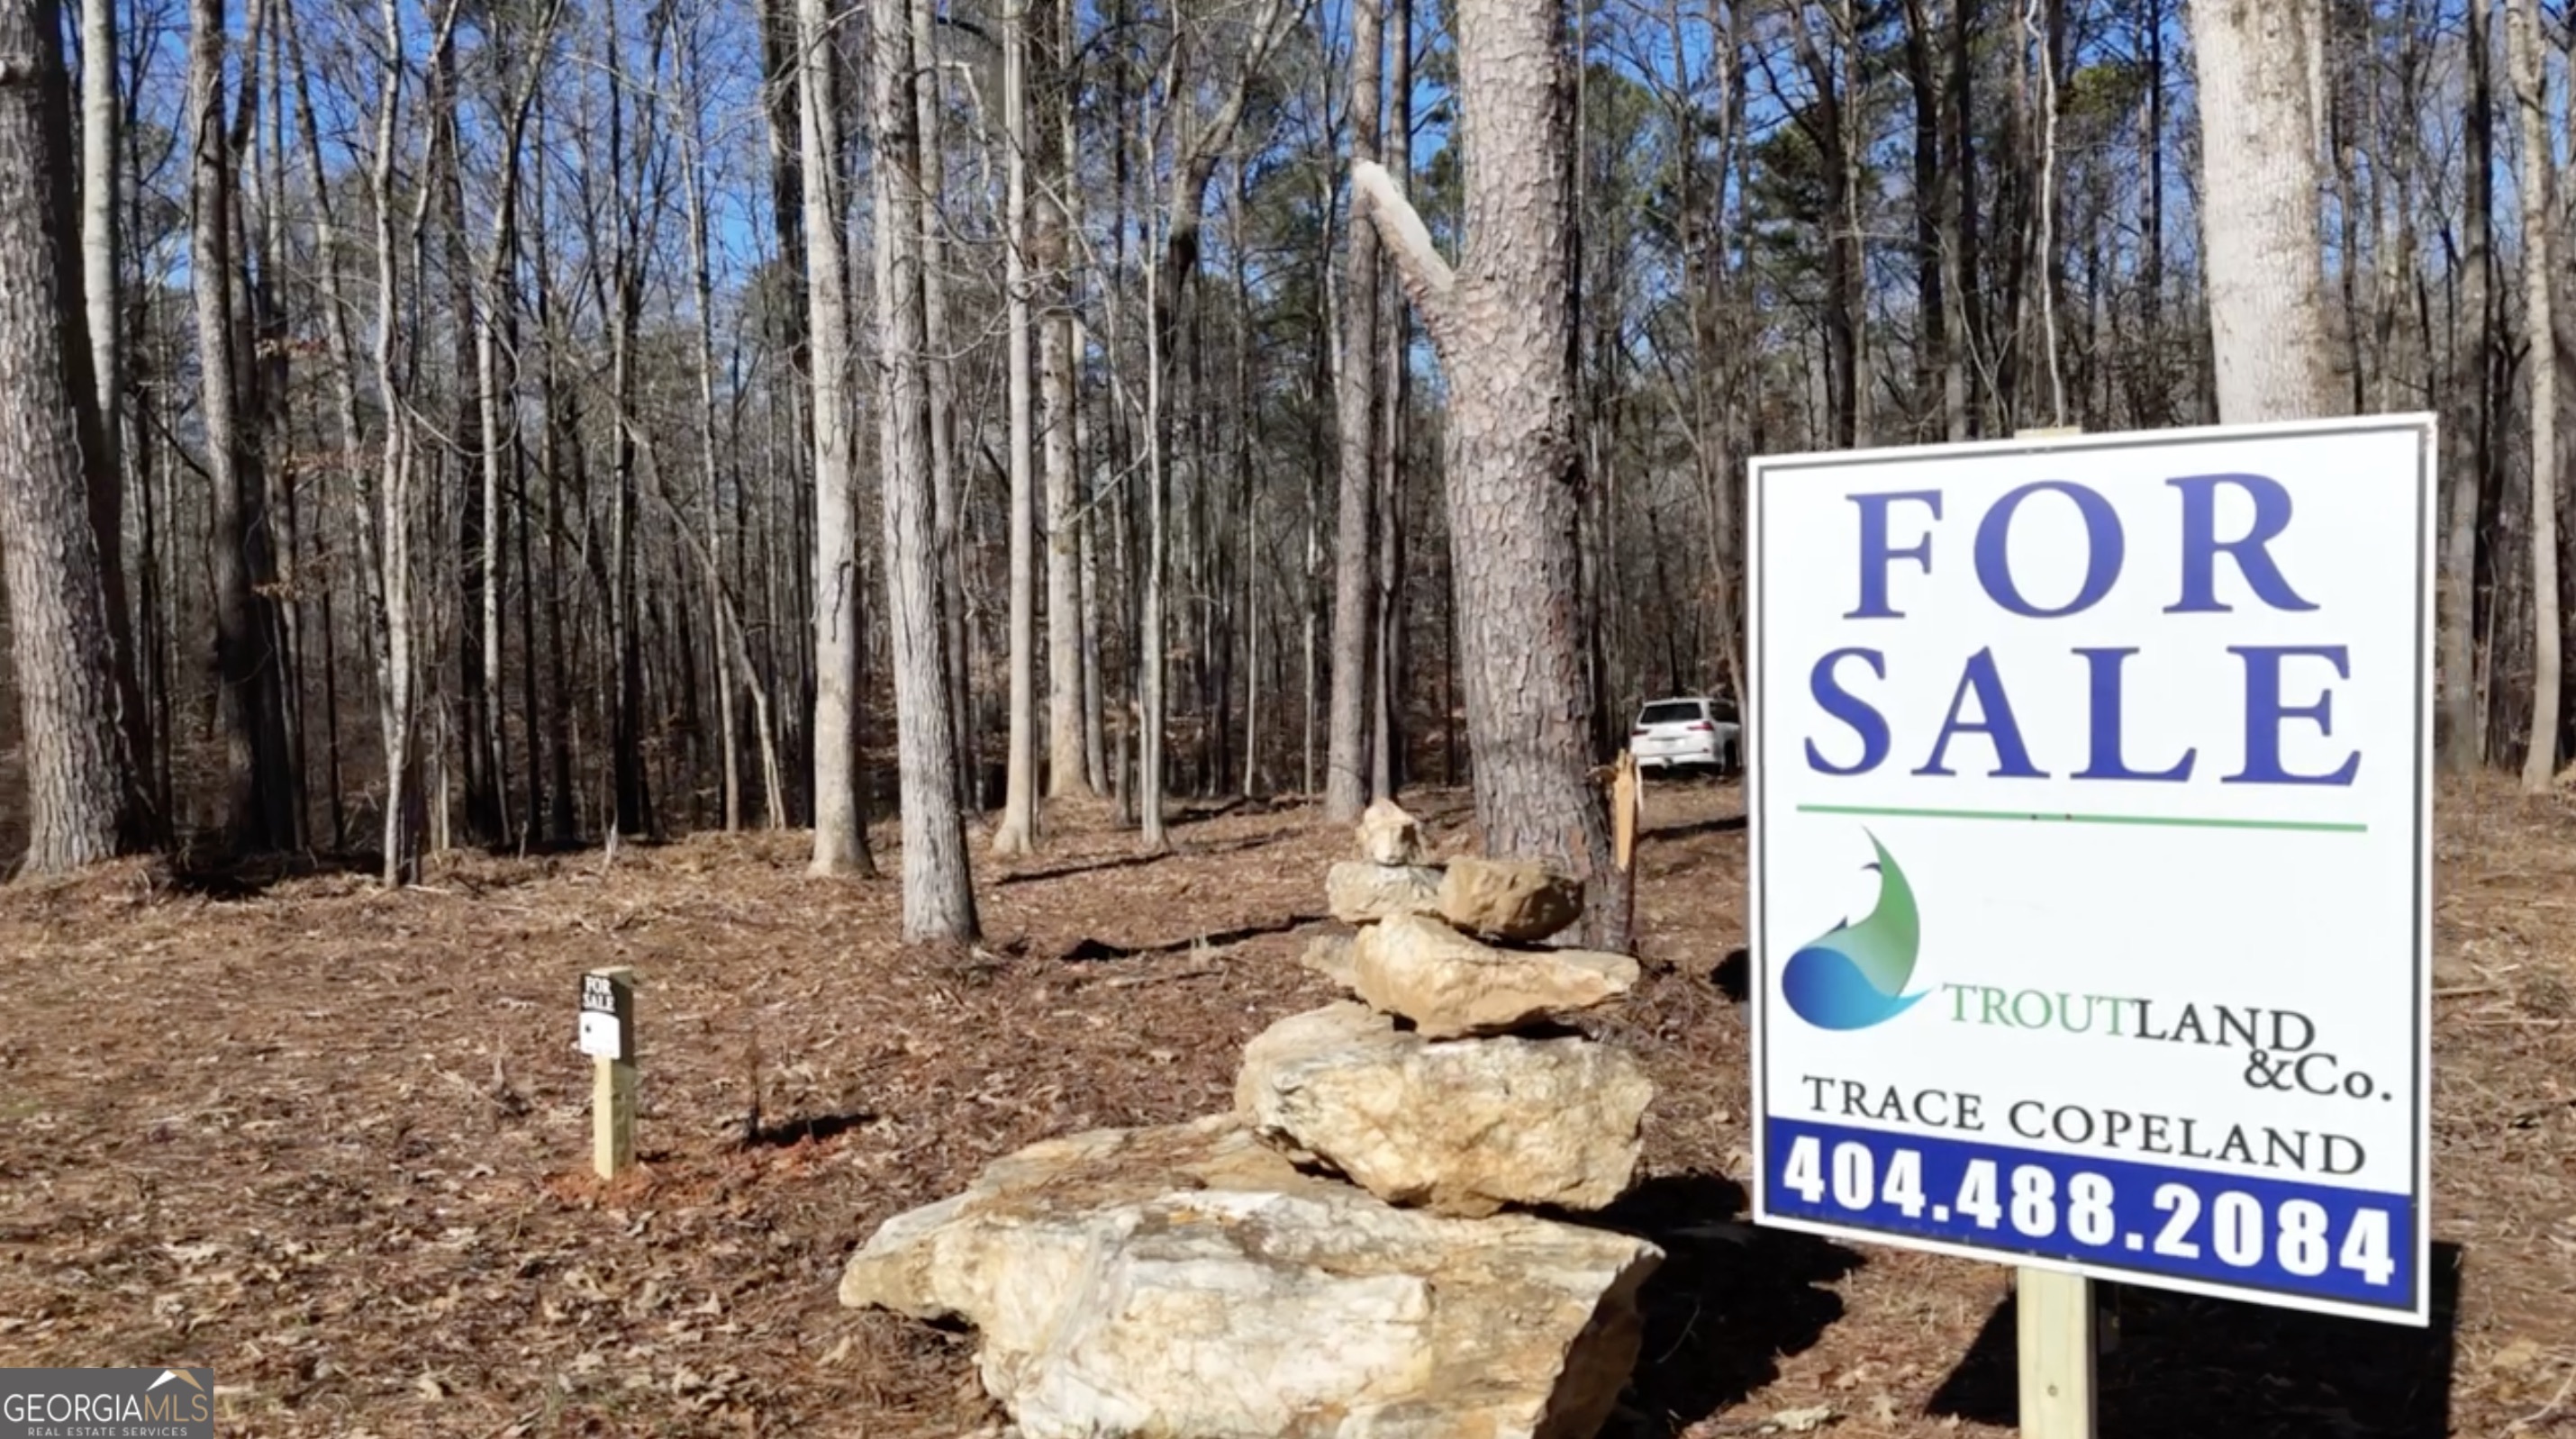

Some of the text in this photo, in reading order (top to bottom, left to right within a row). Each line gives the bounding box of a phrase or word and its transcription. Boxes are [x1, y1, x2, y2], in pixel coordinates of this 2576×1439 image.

[1843, 472, 2321, 620] FOR
[1803, 645, 2362, 786] SALE
[583, 993, 615, 1011] SALE
[585, 976, 612, 993] FOR
[1941, 982, 2317, 1053] TROUTLAND
[2243, 1047, 2393, 1102] &Co.
[1802, 1074, 2366, 1175] TRACE COPELAND
[1782, 1135, 2396, 1286] 404.488.2084
